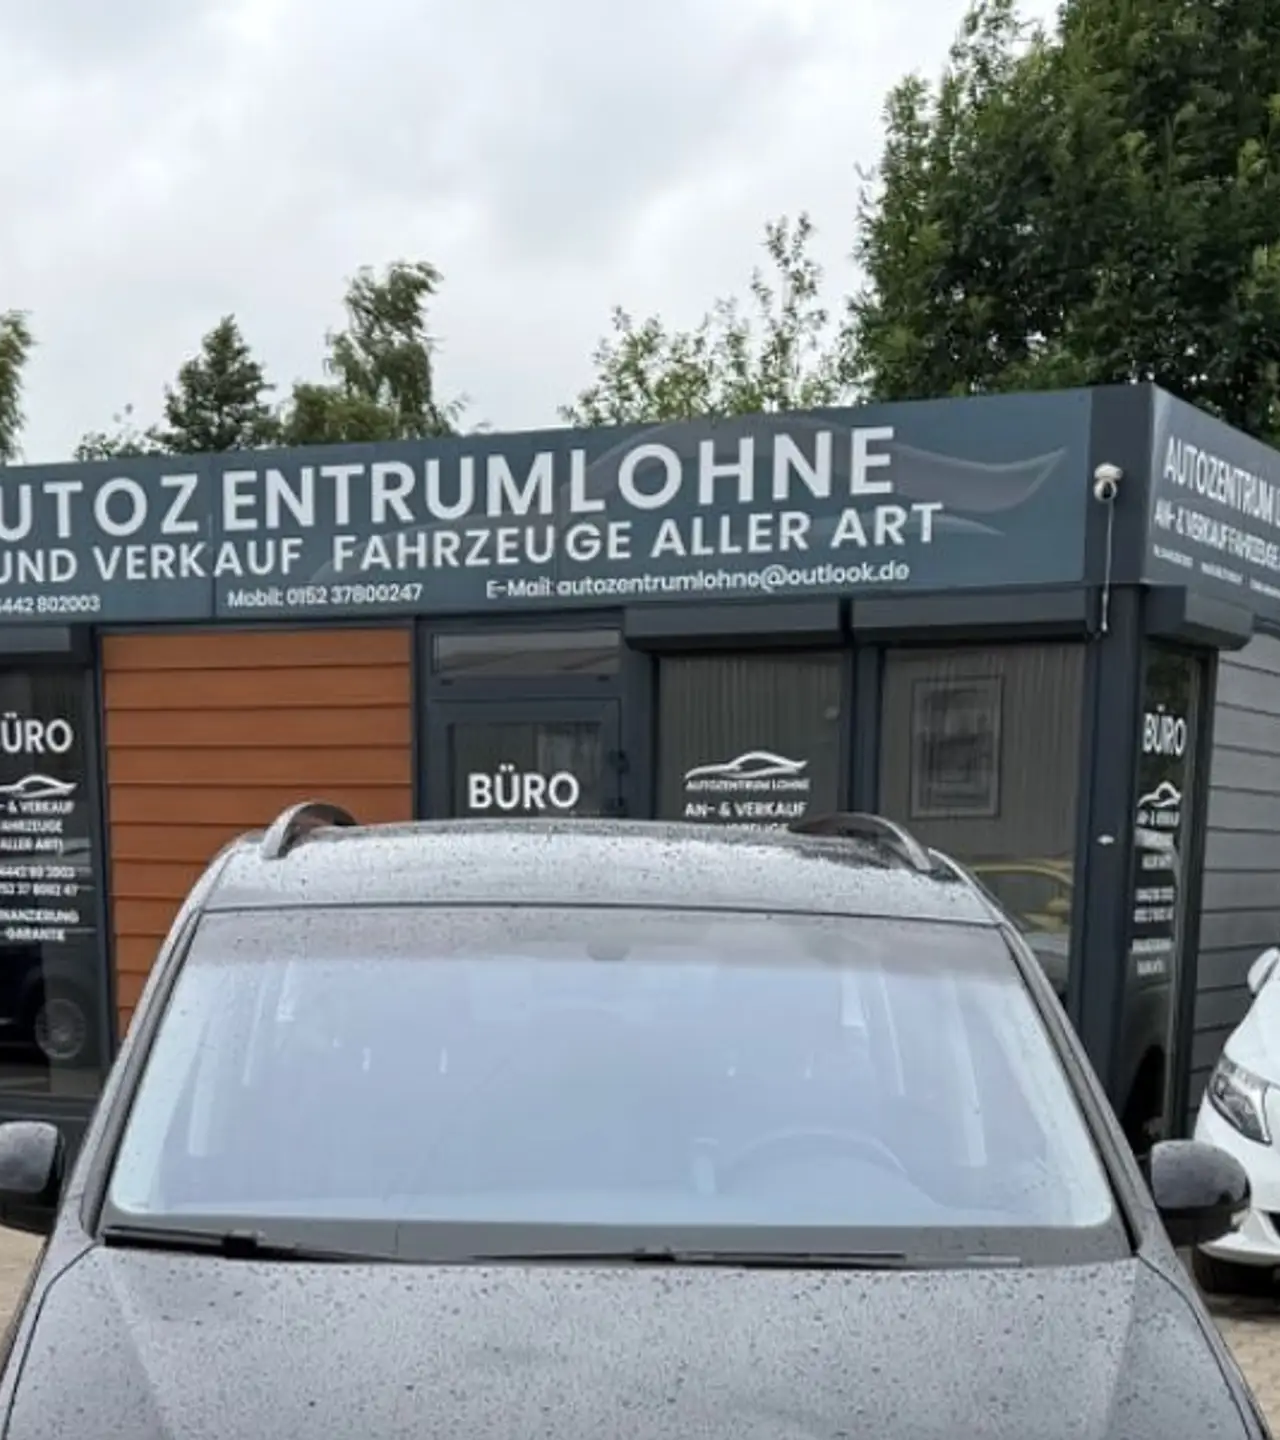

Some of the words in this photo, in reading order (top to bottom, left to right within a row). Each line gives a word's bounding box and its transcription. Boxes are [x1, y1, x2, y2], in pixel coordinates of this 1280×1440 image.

[1163, 435, 1273, 525] AUTOZENTRUM
[92, 537, 303, 581] VERKAUF
[333, 521, 632, 572] FAHRZEUGE
[650, 510, 812, 558] ALLER
[829, 501, 943, 548] ART
[285, 585, 328, 606] 0152
[1143, 703, 1186, 757] BÜRO
[468, 763, 580, 811] BÜRO
[733, 801, 808, 818] VERKAUF
